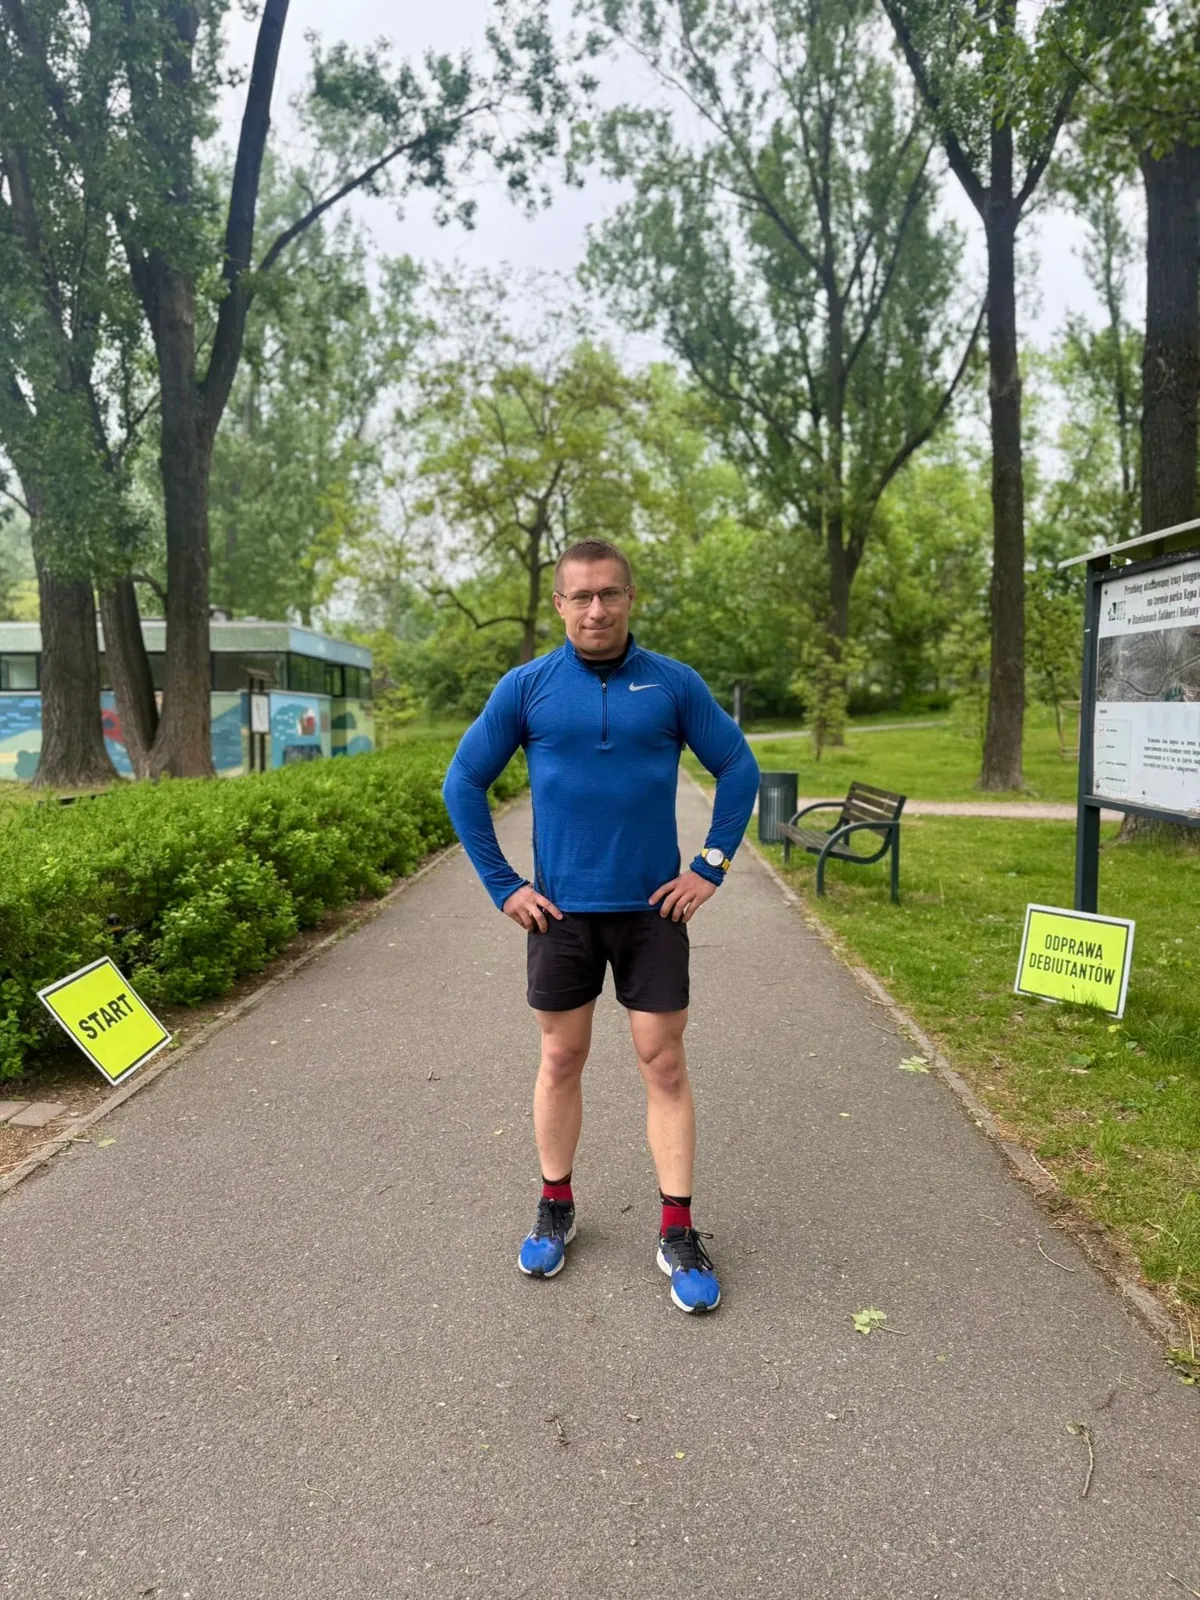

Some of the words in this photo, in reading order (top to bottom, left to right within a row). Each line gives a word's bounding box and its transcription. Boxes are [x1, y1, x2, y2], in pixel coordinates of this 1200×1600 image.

[1044, 933, 1103, 960] ODPRAWA
[1028, 952, 1116, 985] DEBIUTANTÓW
[78, 993, 134, 1040] START
